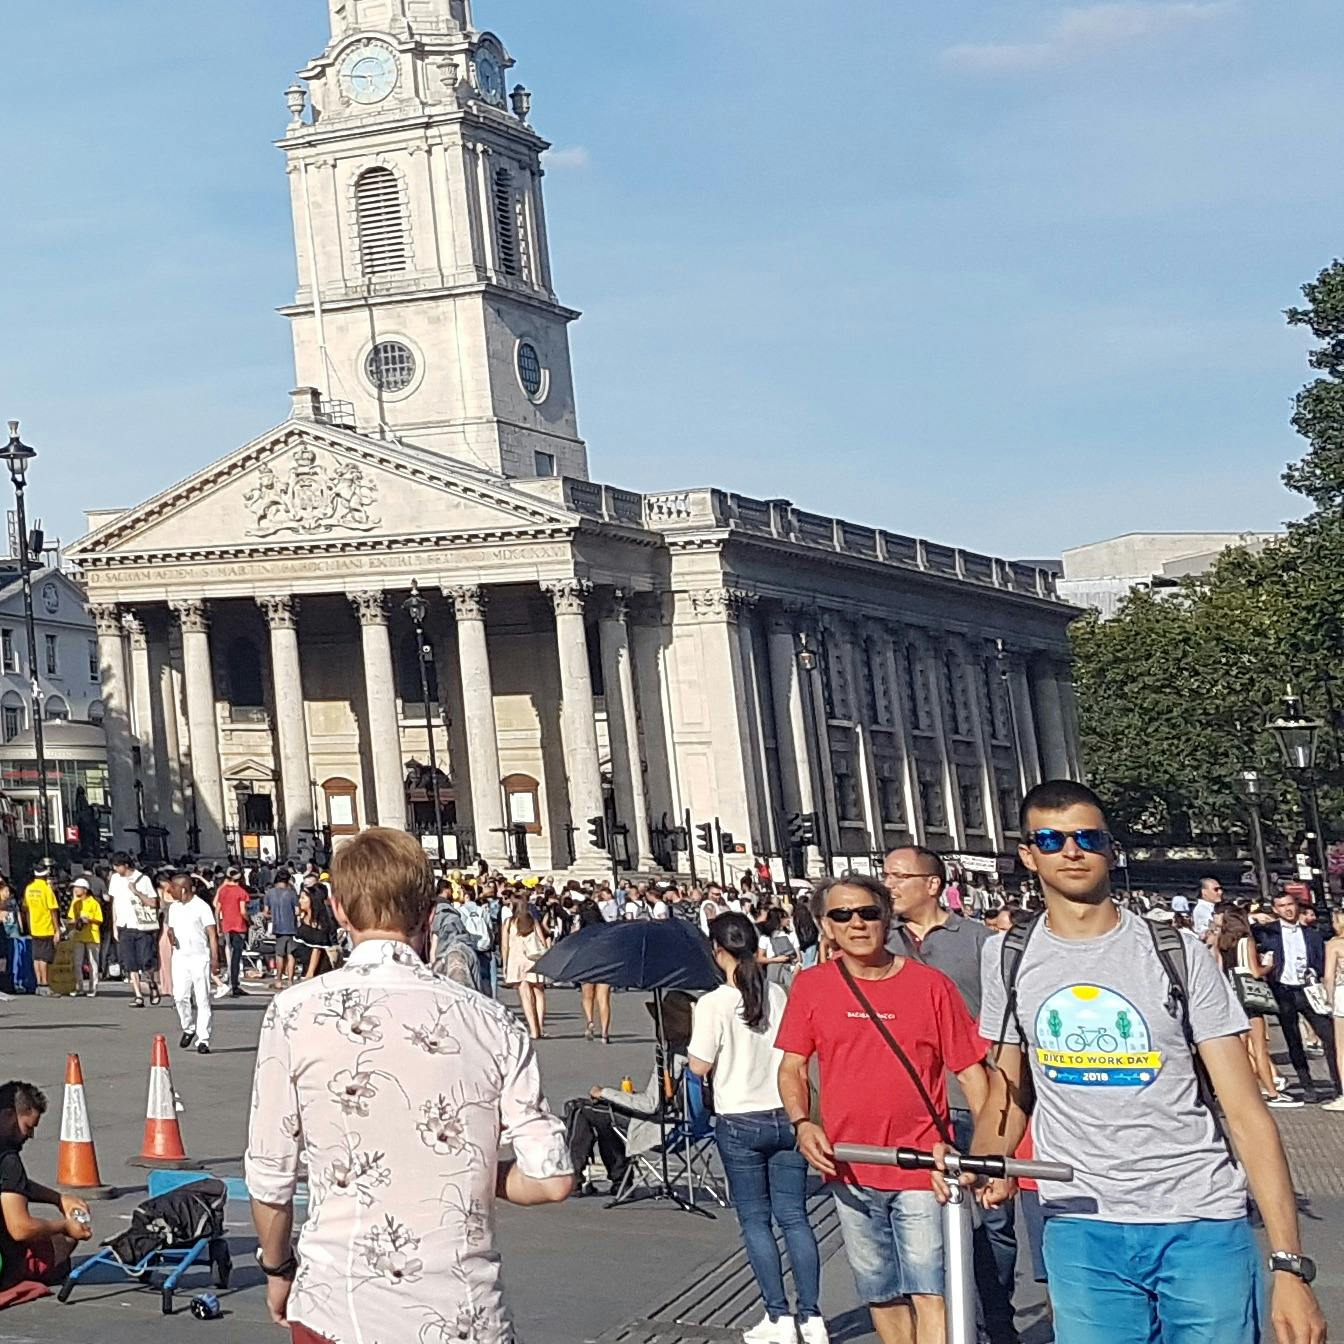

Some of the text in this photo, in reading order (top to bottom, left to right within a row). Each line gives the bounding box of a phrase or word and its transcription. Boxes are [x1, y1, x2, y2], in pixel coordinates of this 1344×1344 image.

[1043, 1053, 1149, 1065] BIKE TO WORK DAY
